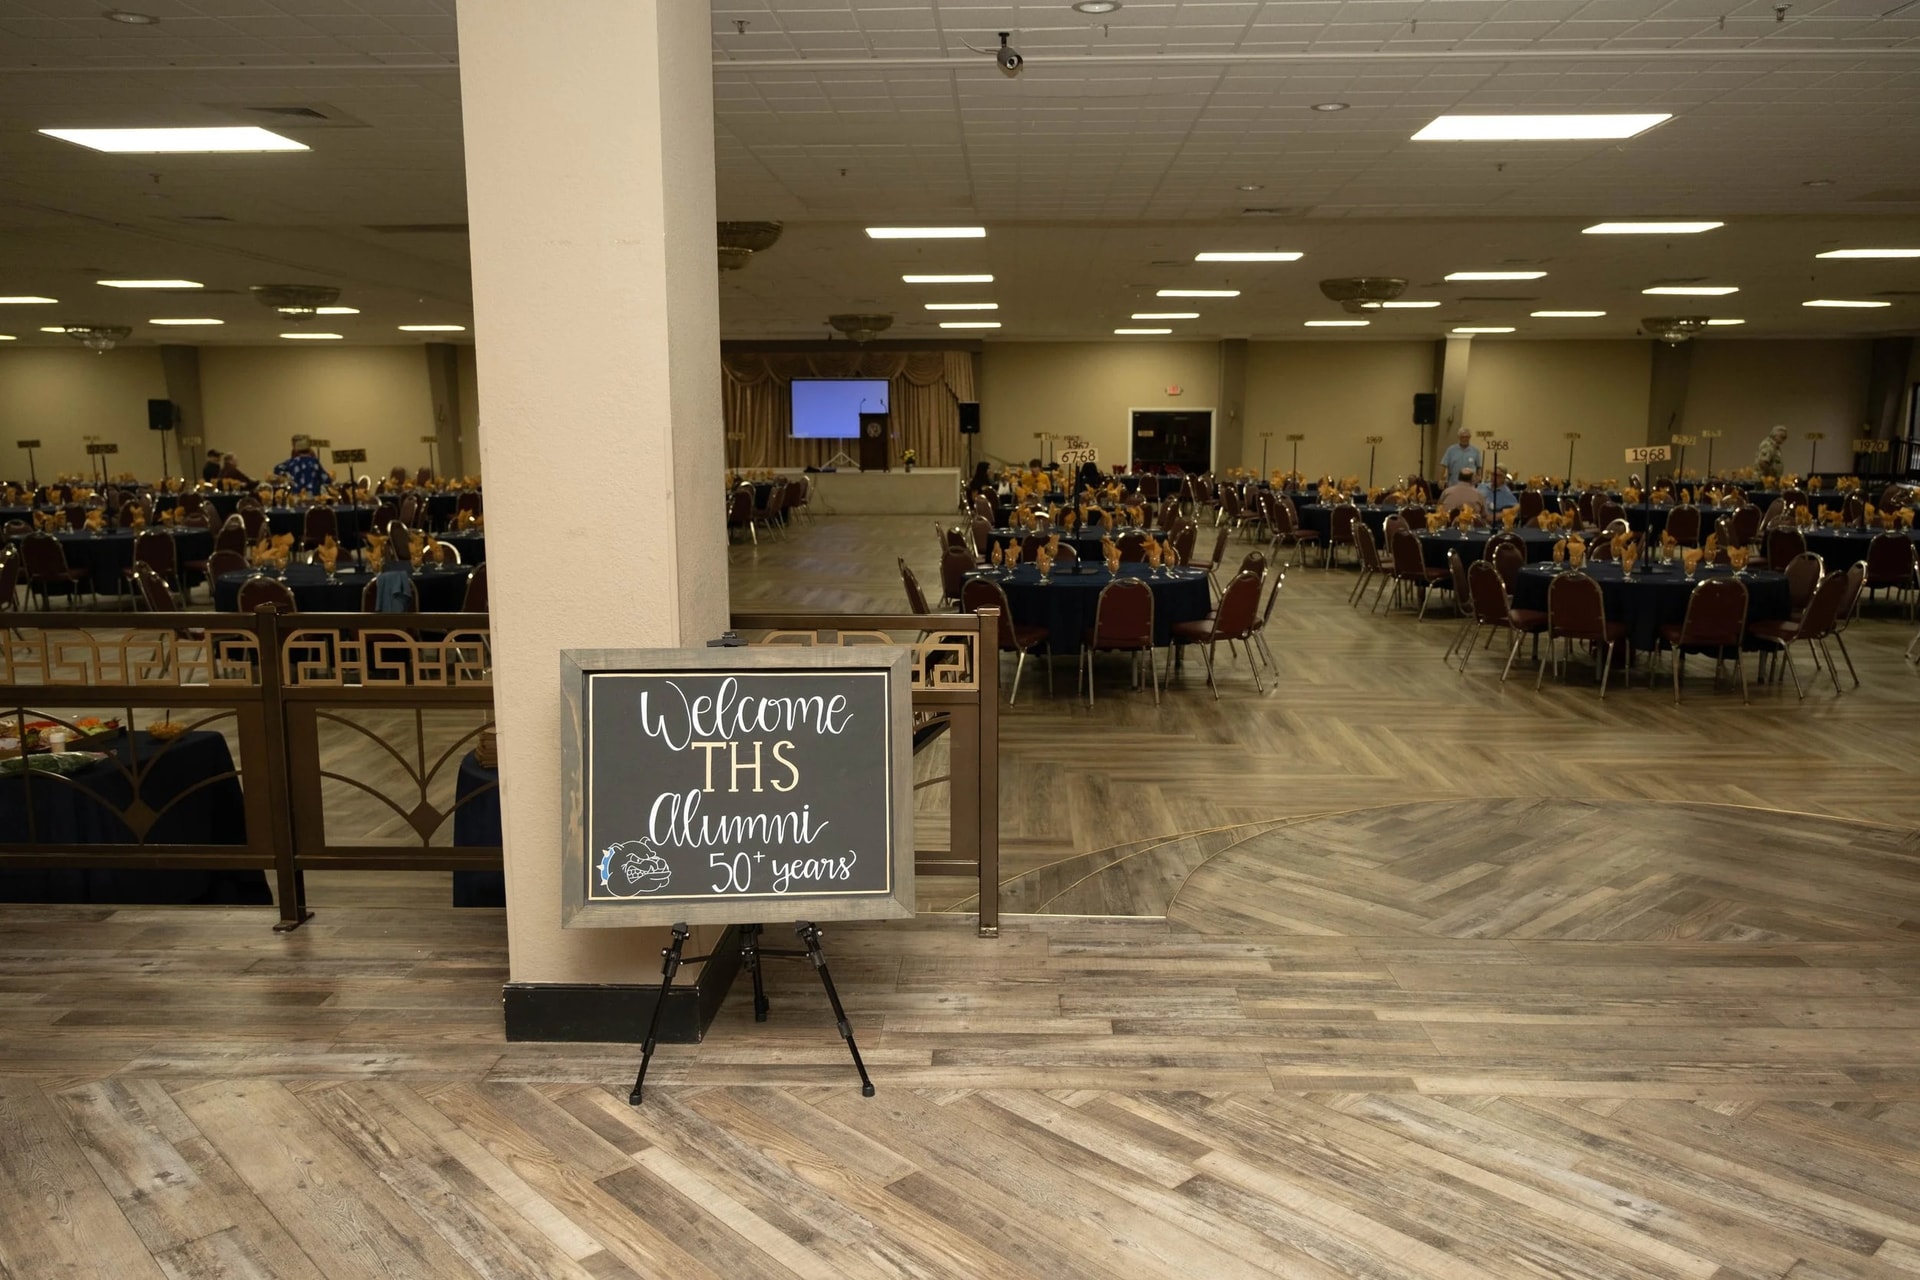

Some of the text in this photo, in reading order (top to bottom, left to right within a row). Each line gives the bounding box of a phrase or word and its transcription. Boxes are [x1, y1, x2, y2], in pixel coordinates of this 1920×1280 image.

[1067, 440, 1090, 449] 1967
[1486, 440, 1509, 450] 1968
[1860, 440, 1885, 451] 1970
[1061, 449, 1096, 463] 67-68
[1632, 448, 1665, 462] 1968
[640, 677, 854, 751] Welcome
[691, 740, 800, 793] THS
[649, 789, 829, 848] Alumni
[772, 850, 857, 894] years
